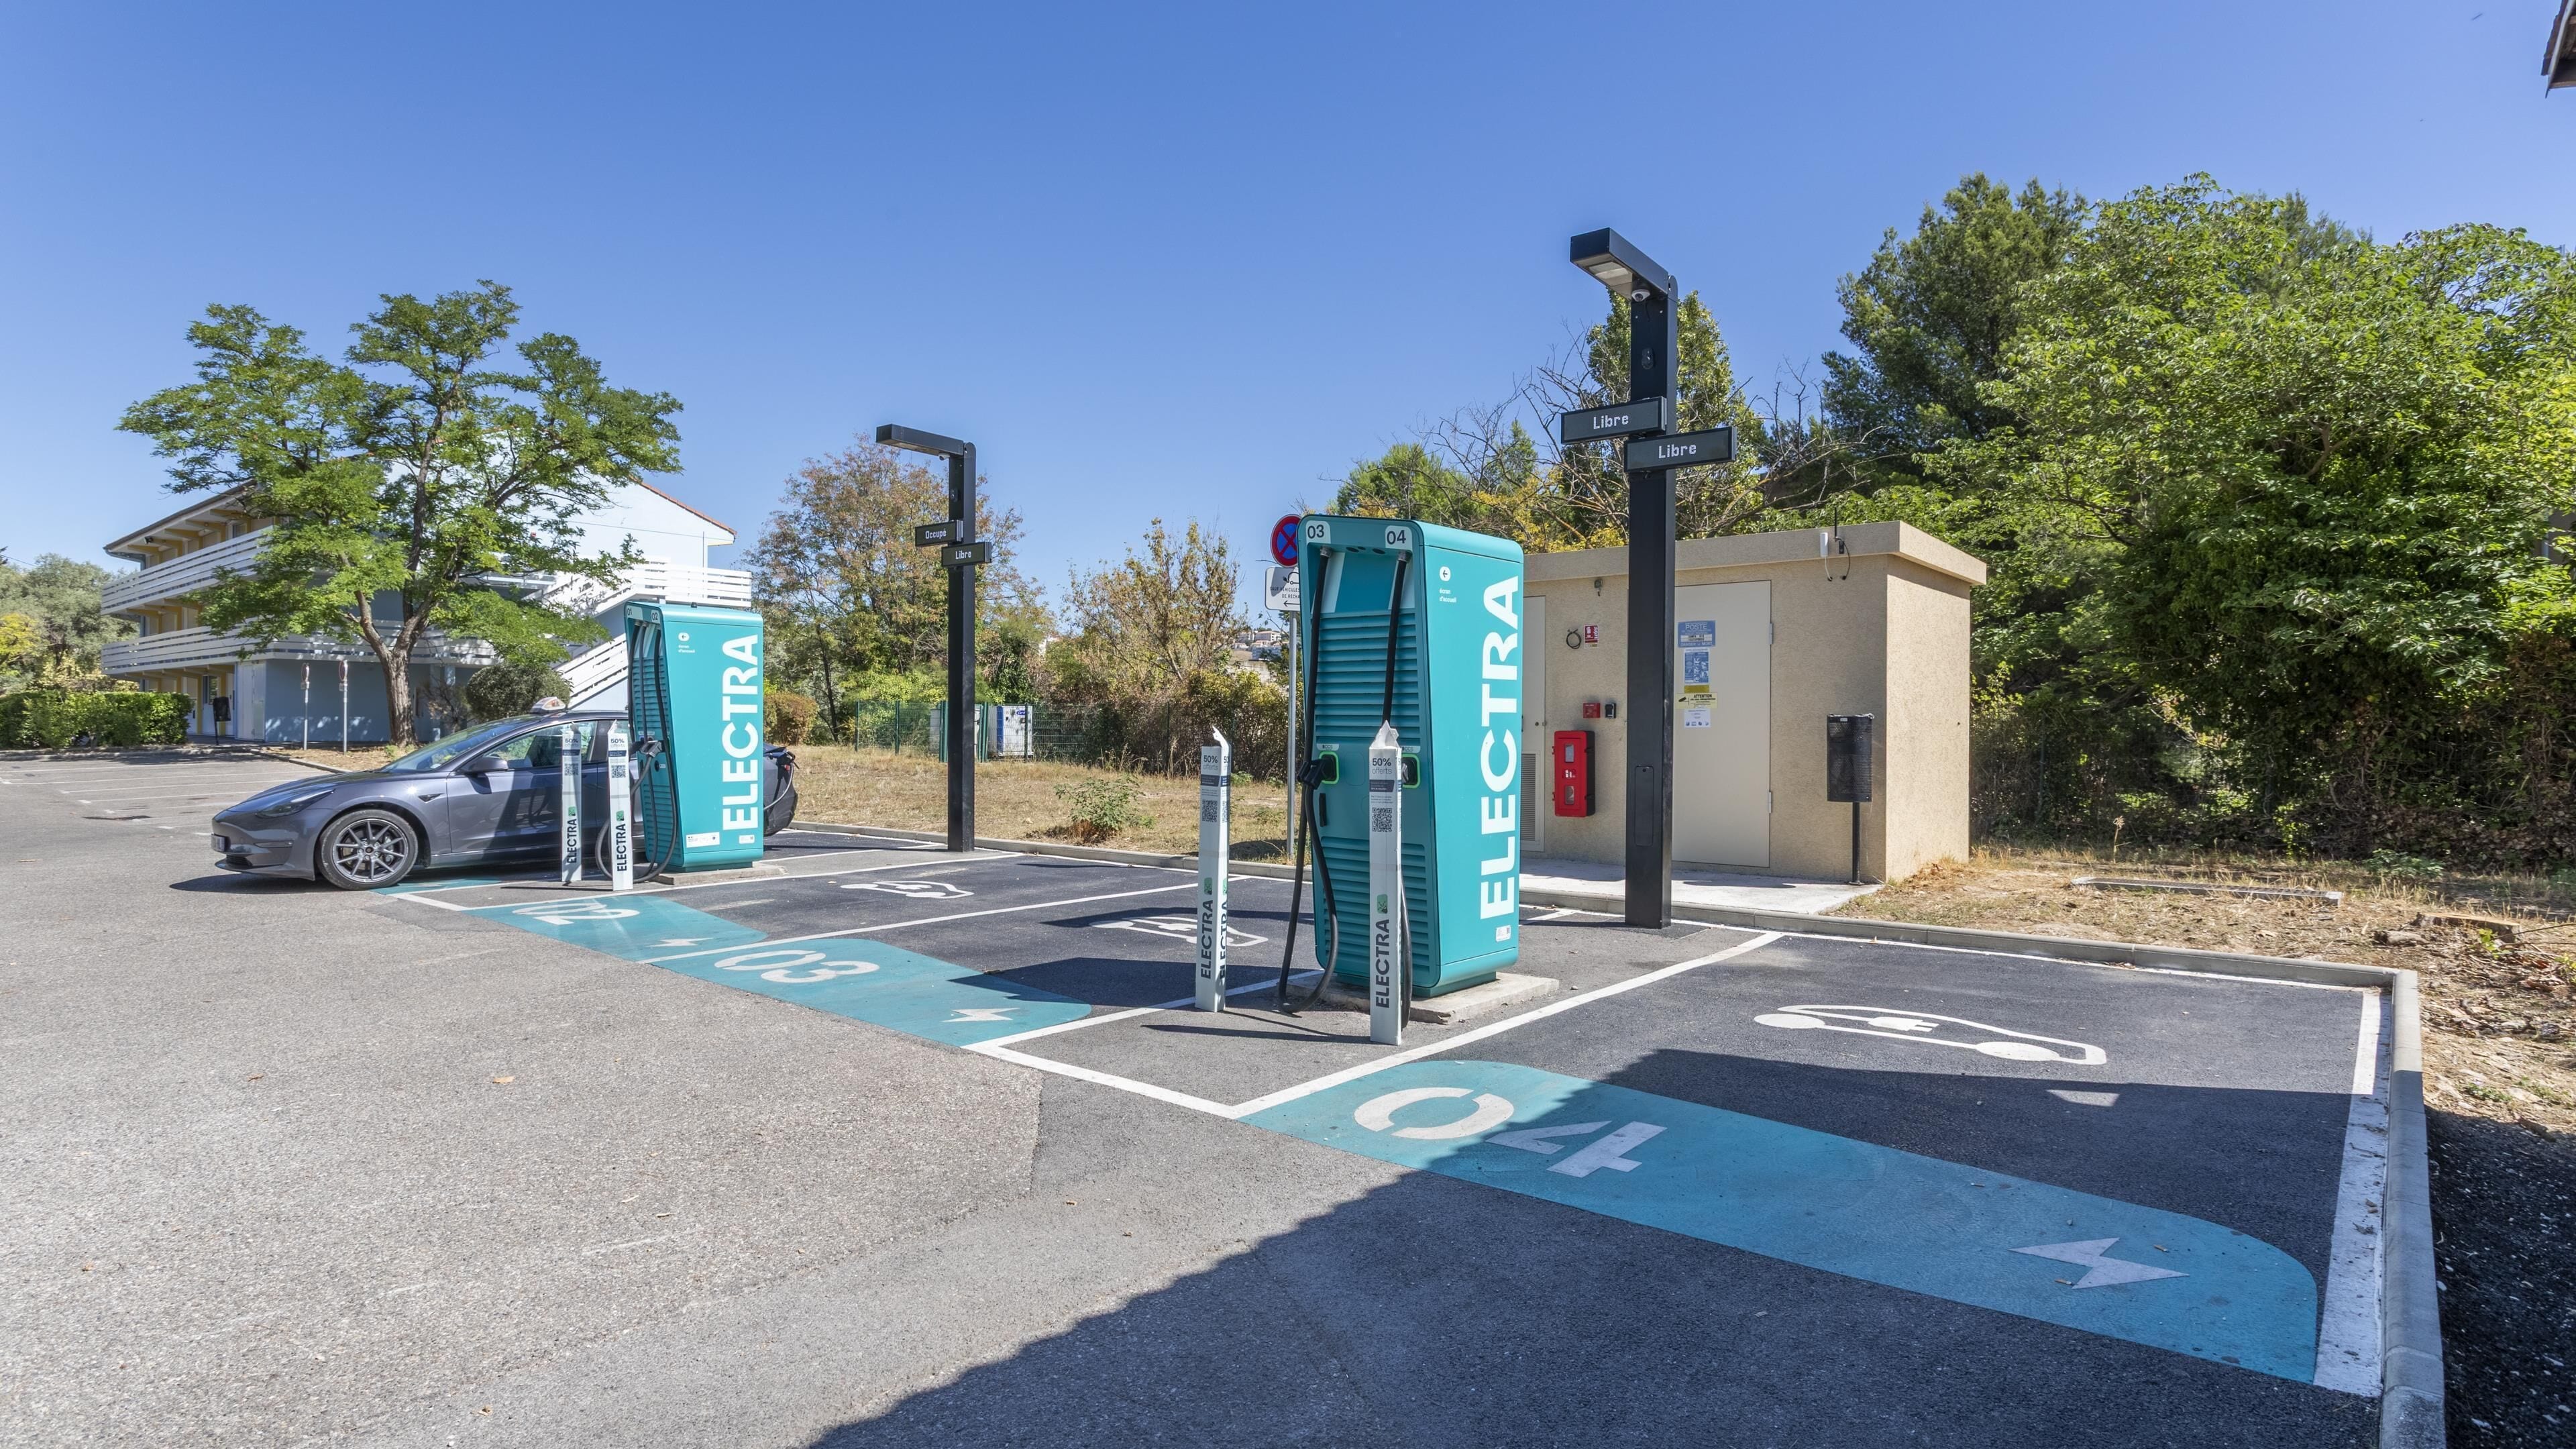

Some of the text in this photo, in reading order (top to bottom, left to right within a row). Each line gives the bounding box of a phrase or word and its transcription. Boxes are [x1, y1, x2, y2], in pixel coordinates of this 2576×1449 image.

[1593, 415, 1629, 429] Libre
[1658, 443, 1697, 459] Libre
[925, 528, 947, 539] Occupé
[1307, 524, 1325, 539] 03
[1387, 529, 1407, 545] 04
[955, 550, 972, 559] Libre
[651, 612, 658, 621] 02
[722, 634, 759, 830] ELECTRA
[1480, 575, 1519, 920] ELECTRA
[1203, 755, 1218, 763] 50%
[1372, 757, 1391, 766] 50%
[567, 818, 577, 863] ELECTRA
[617, 823, 627, 871] ELECTRA
[1201, 900, 1214, 979] ELECTRA
[714, 949, 880, 983] 03
[1375, 918, 1390, 1008] ELECTRA
[1354, 1087, 1668, 1178] 04
